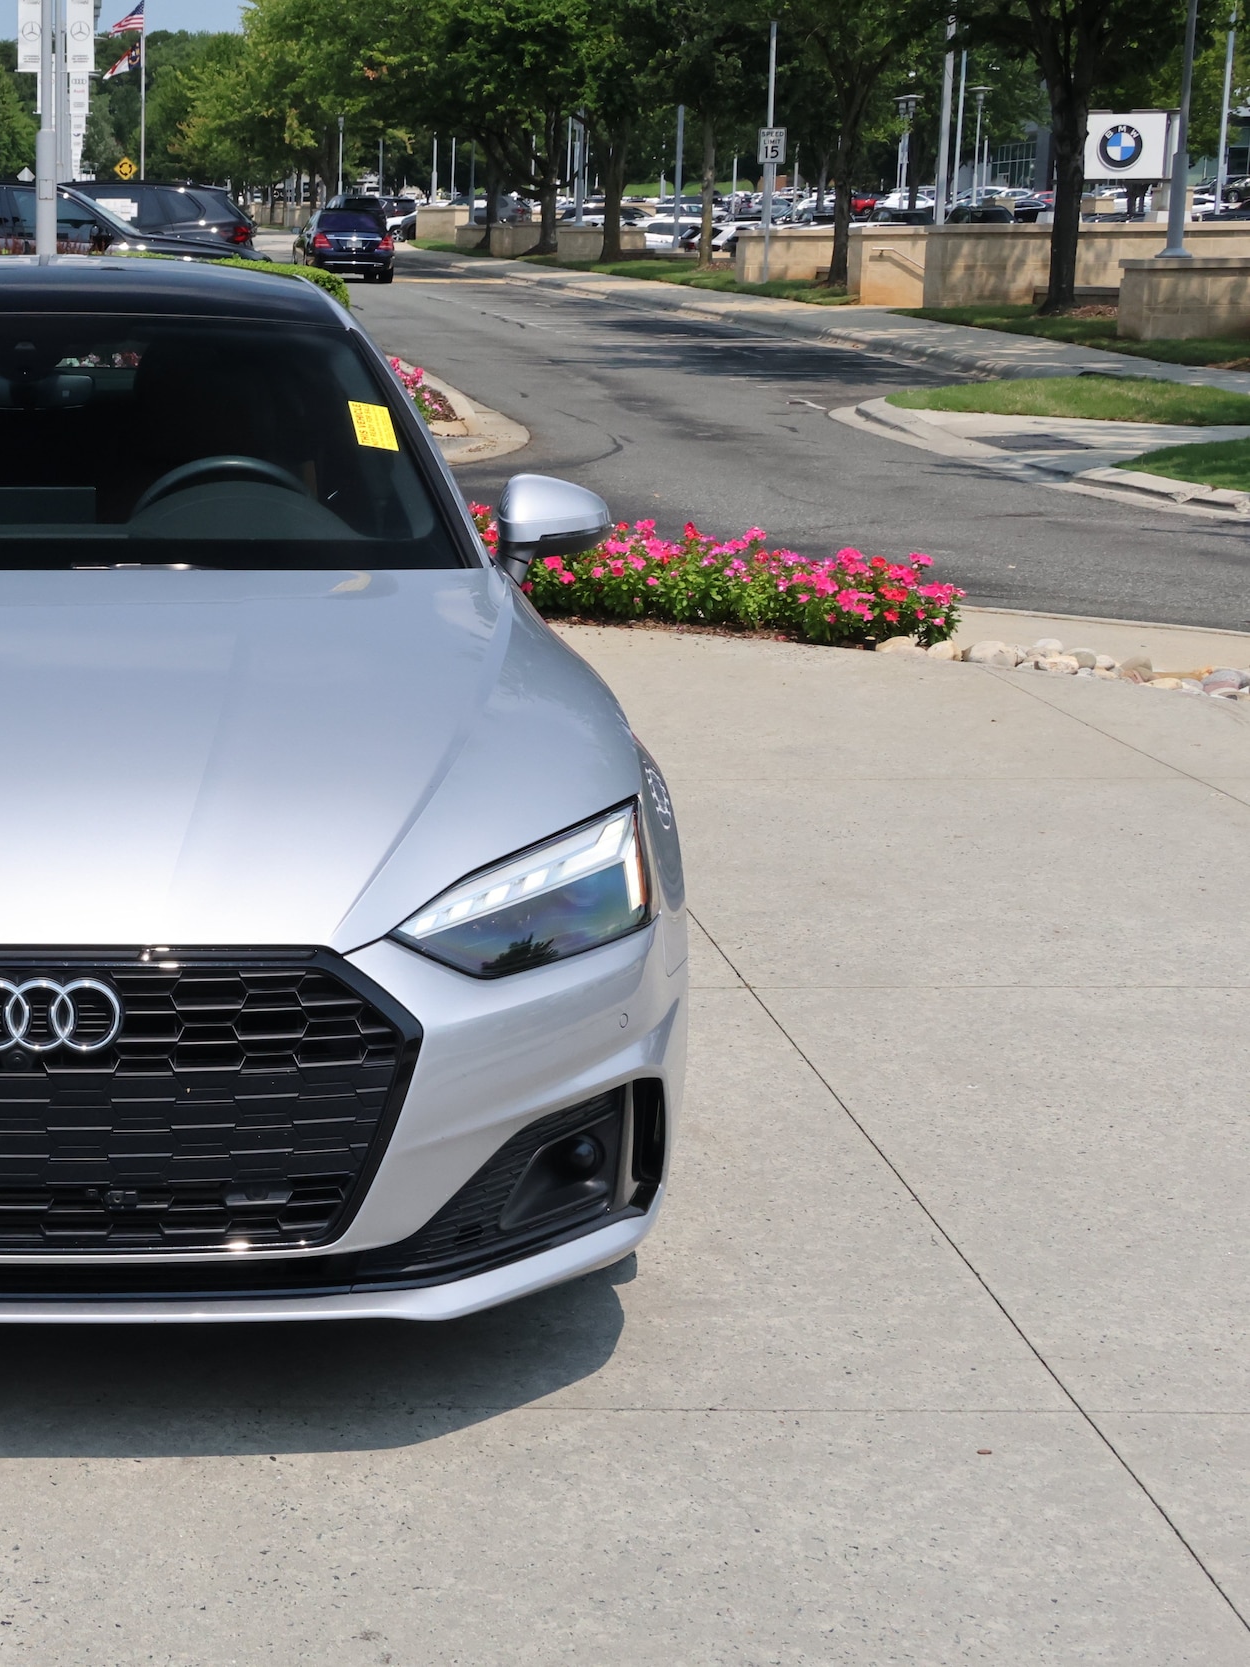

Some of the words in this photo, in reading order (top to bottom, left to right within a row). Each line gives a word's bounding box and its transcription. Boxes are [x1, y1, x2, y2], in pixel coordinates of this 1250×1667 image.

[1104, 125, 1139, 139] BMW
[765, 145, 779, 159] 15
[351, 403, 366, 428] VEHICLE
[358, 429, 370, 444] THIS
